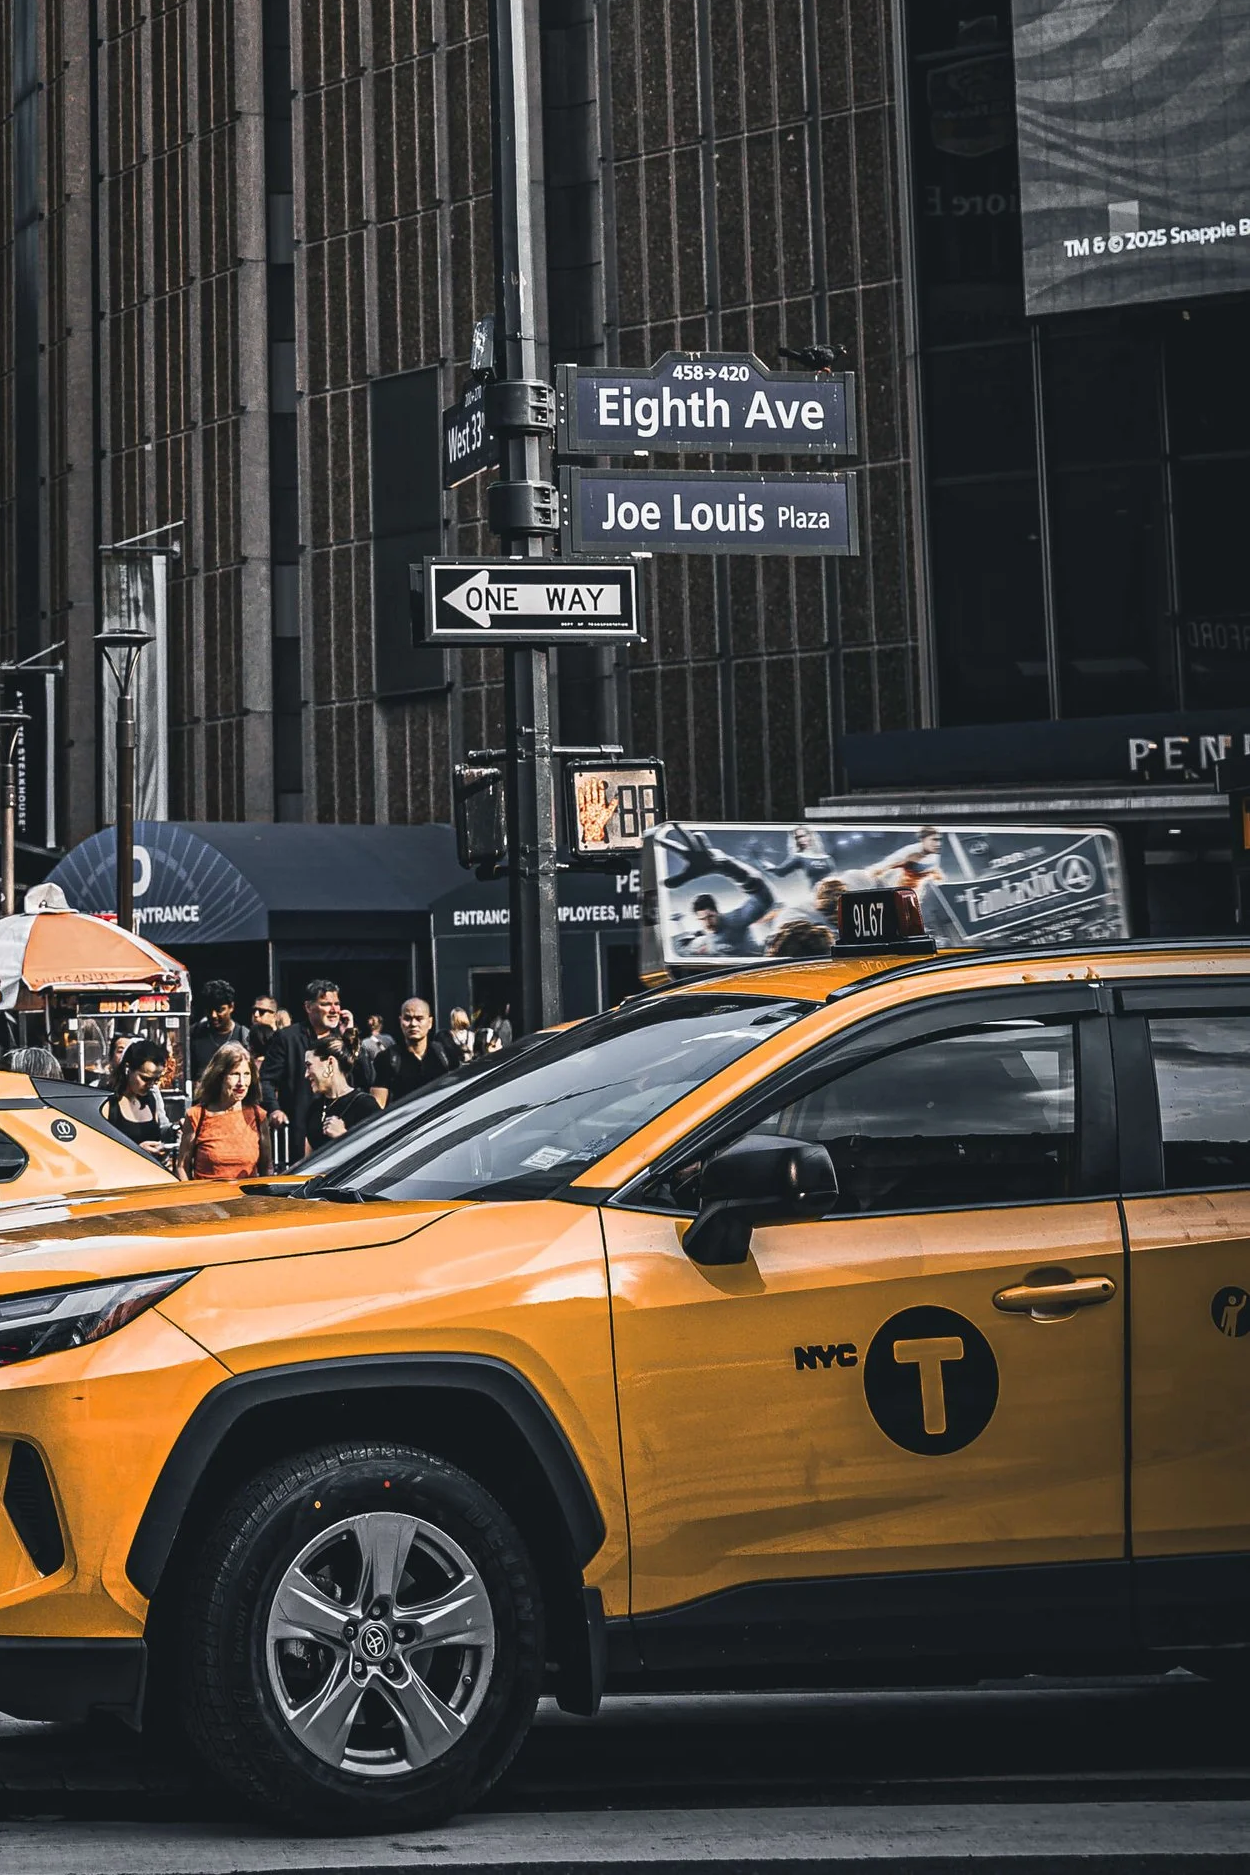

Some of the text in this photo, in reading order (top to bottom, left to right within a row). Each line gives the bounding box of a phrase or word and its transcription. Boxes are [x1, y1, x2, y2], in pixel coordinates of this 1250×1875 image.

[1063, 239, 1090, 258] TM
[1171, 220, 1236, 246] Snapple
[597, 387, 825, 437] Eighth Ave
[448, 421, 470, 464] West
[602, 493, 830, 533] Joe Louis Plaza
[465, 586, 605, 612] ONE WAY
[853, 903, 884, 938] 9L67
[794, 1343, 858, 1371] NYC
[892, 1336, 965, 1435] T
